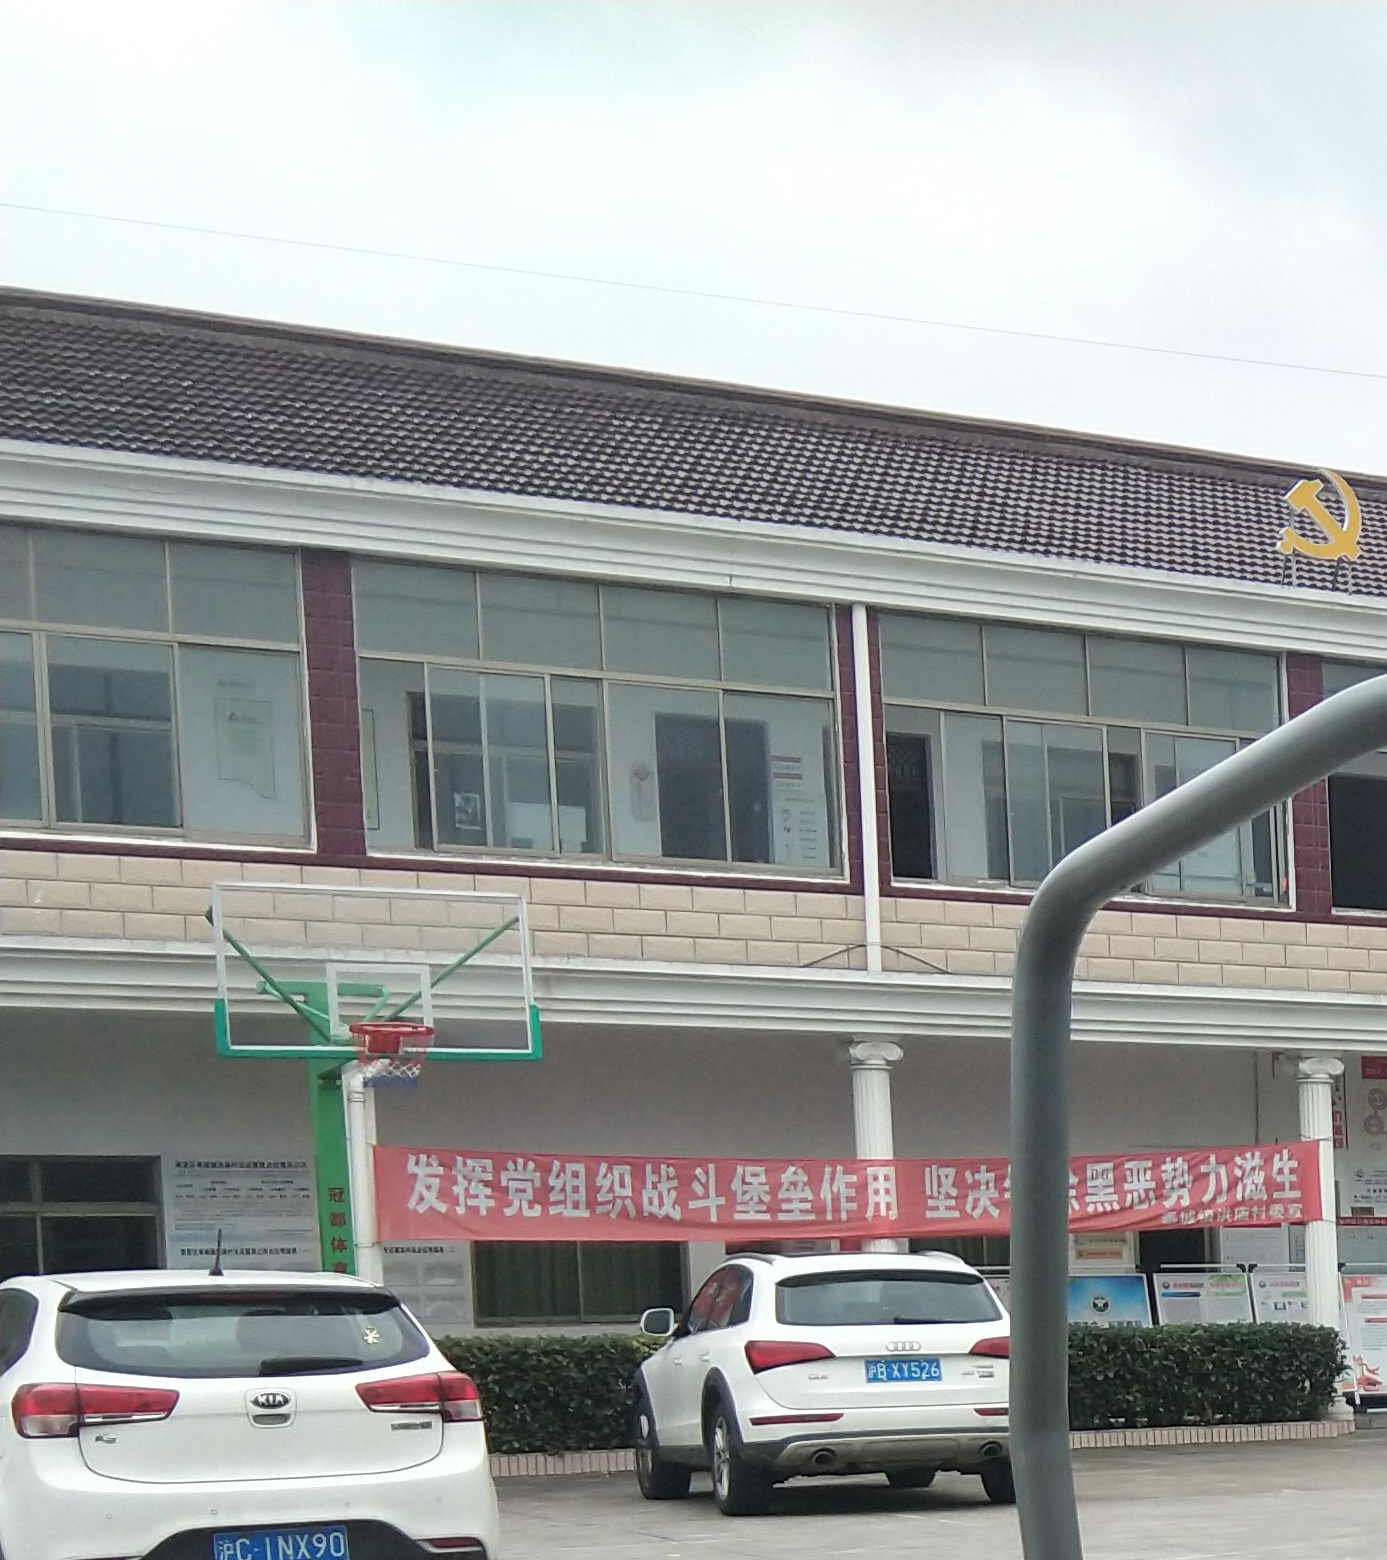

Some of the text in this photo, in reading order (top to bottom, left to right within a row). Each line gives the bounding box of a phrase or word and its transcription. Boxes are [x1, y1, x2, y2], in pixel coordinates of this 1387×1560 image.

[404, 1152, 898, 1222] 发挥党组织战斗堡垒作用
[924, 1149, 1302, 1219] 坚决黑恶势力滋生
[258, 1393, 284, 1406] KIA
